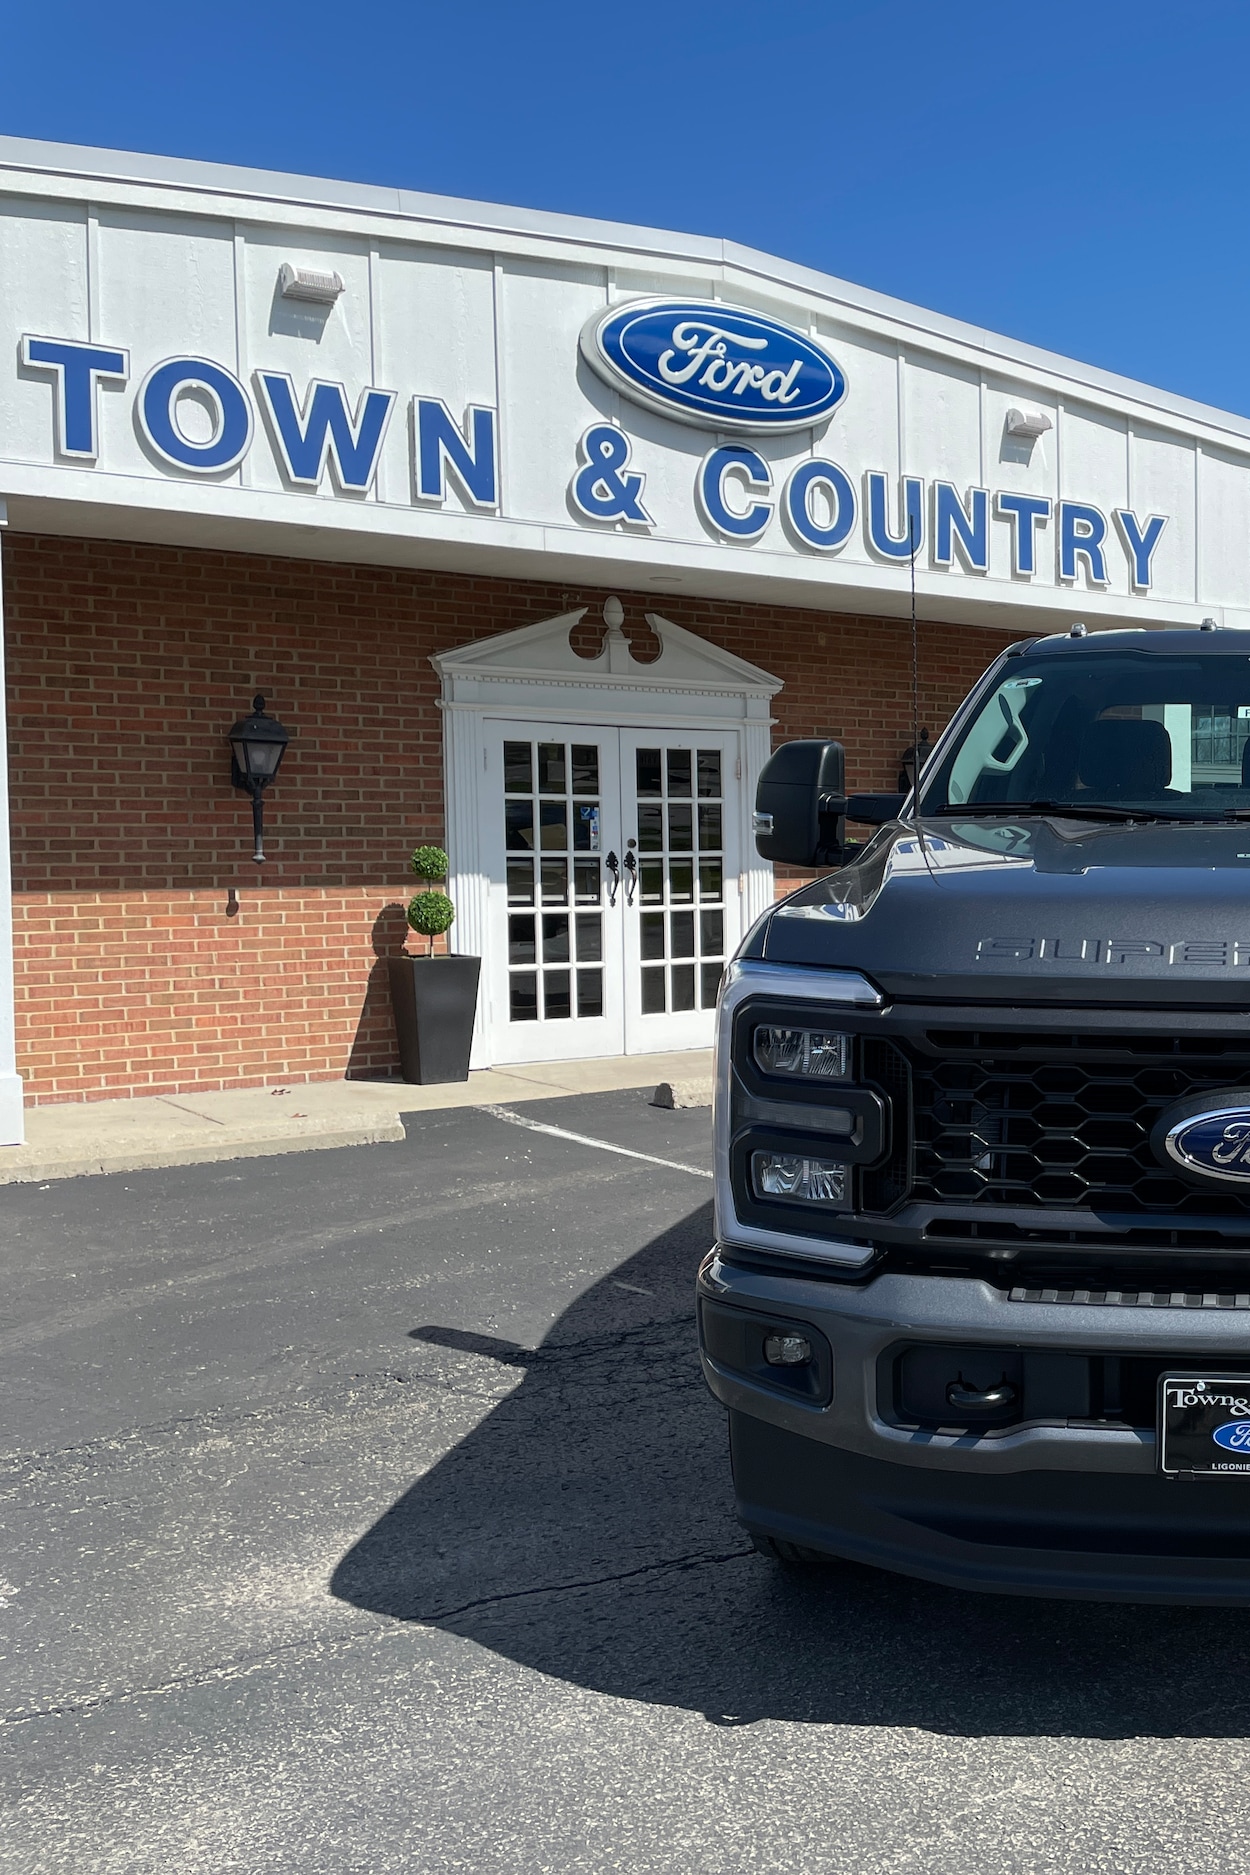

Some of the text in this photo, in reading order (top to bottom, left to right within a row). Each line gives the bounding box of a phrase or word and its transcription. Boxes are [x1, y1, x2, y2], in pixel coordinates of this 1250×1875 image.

[657, 321, 805, 407] Ford
[20, 333, 1169, 590] TOWN & COUNTRY
